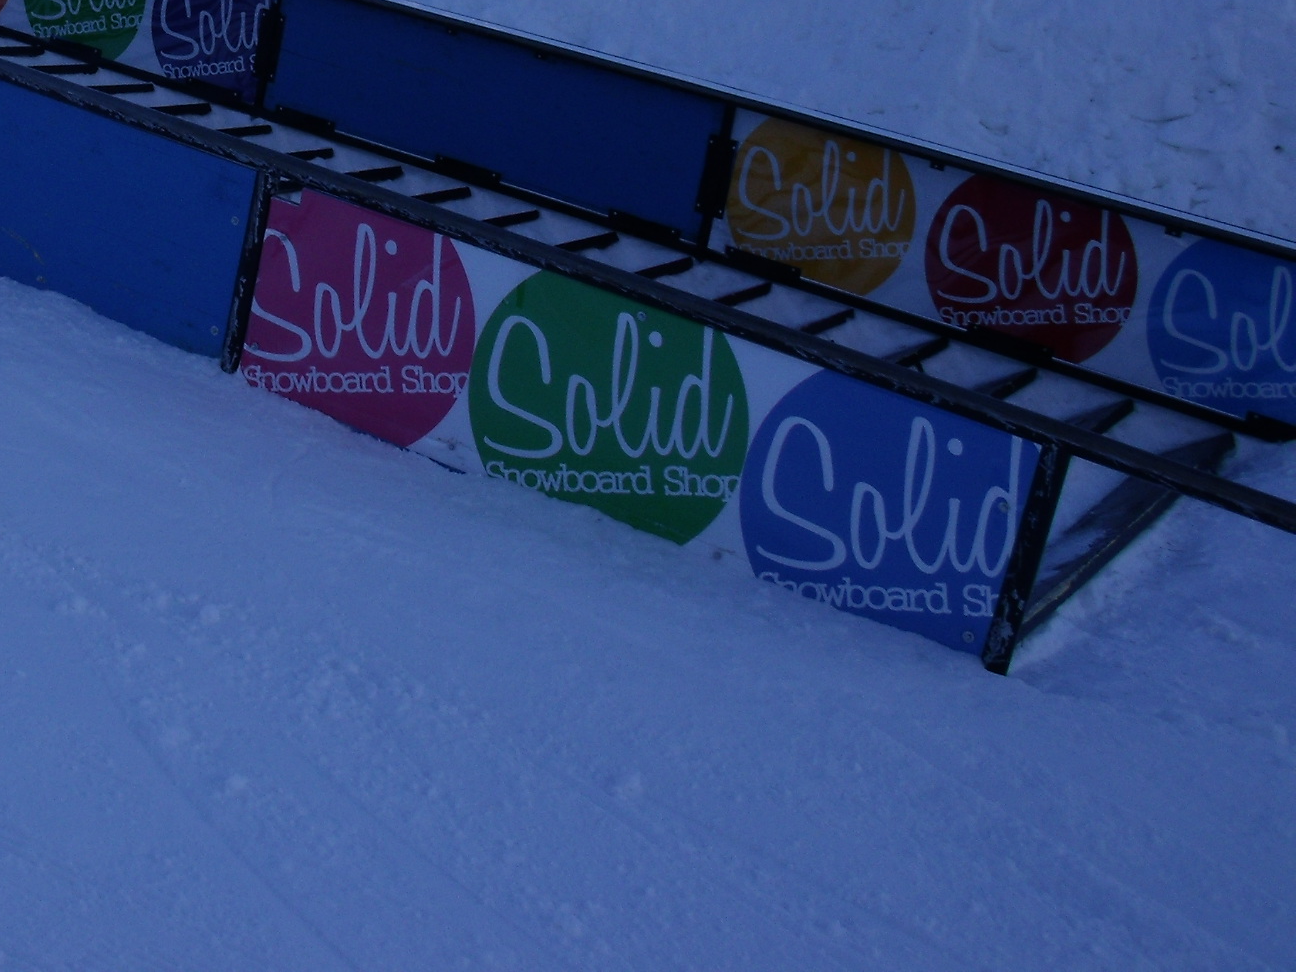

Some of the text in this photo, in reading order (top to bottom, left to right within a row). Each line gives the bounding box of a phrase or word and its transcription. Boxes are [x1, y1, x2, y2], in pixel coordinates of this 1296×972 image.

[32, 18, 106, 39] Snowboard
[162, 55, 247, 79] Snowboard
[733, 139, 905, 241] Solid
[243, 223, 462, 362] Solid
[937, 198, 1126, 304] Solid
[939, 304, 1067, 327] Snowboard
[243, 364, 395, 395] Snowboard
[483, 312, 733, 460] Solid
[756, 416, 1023, 579] Solid
